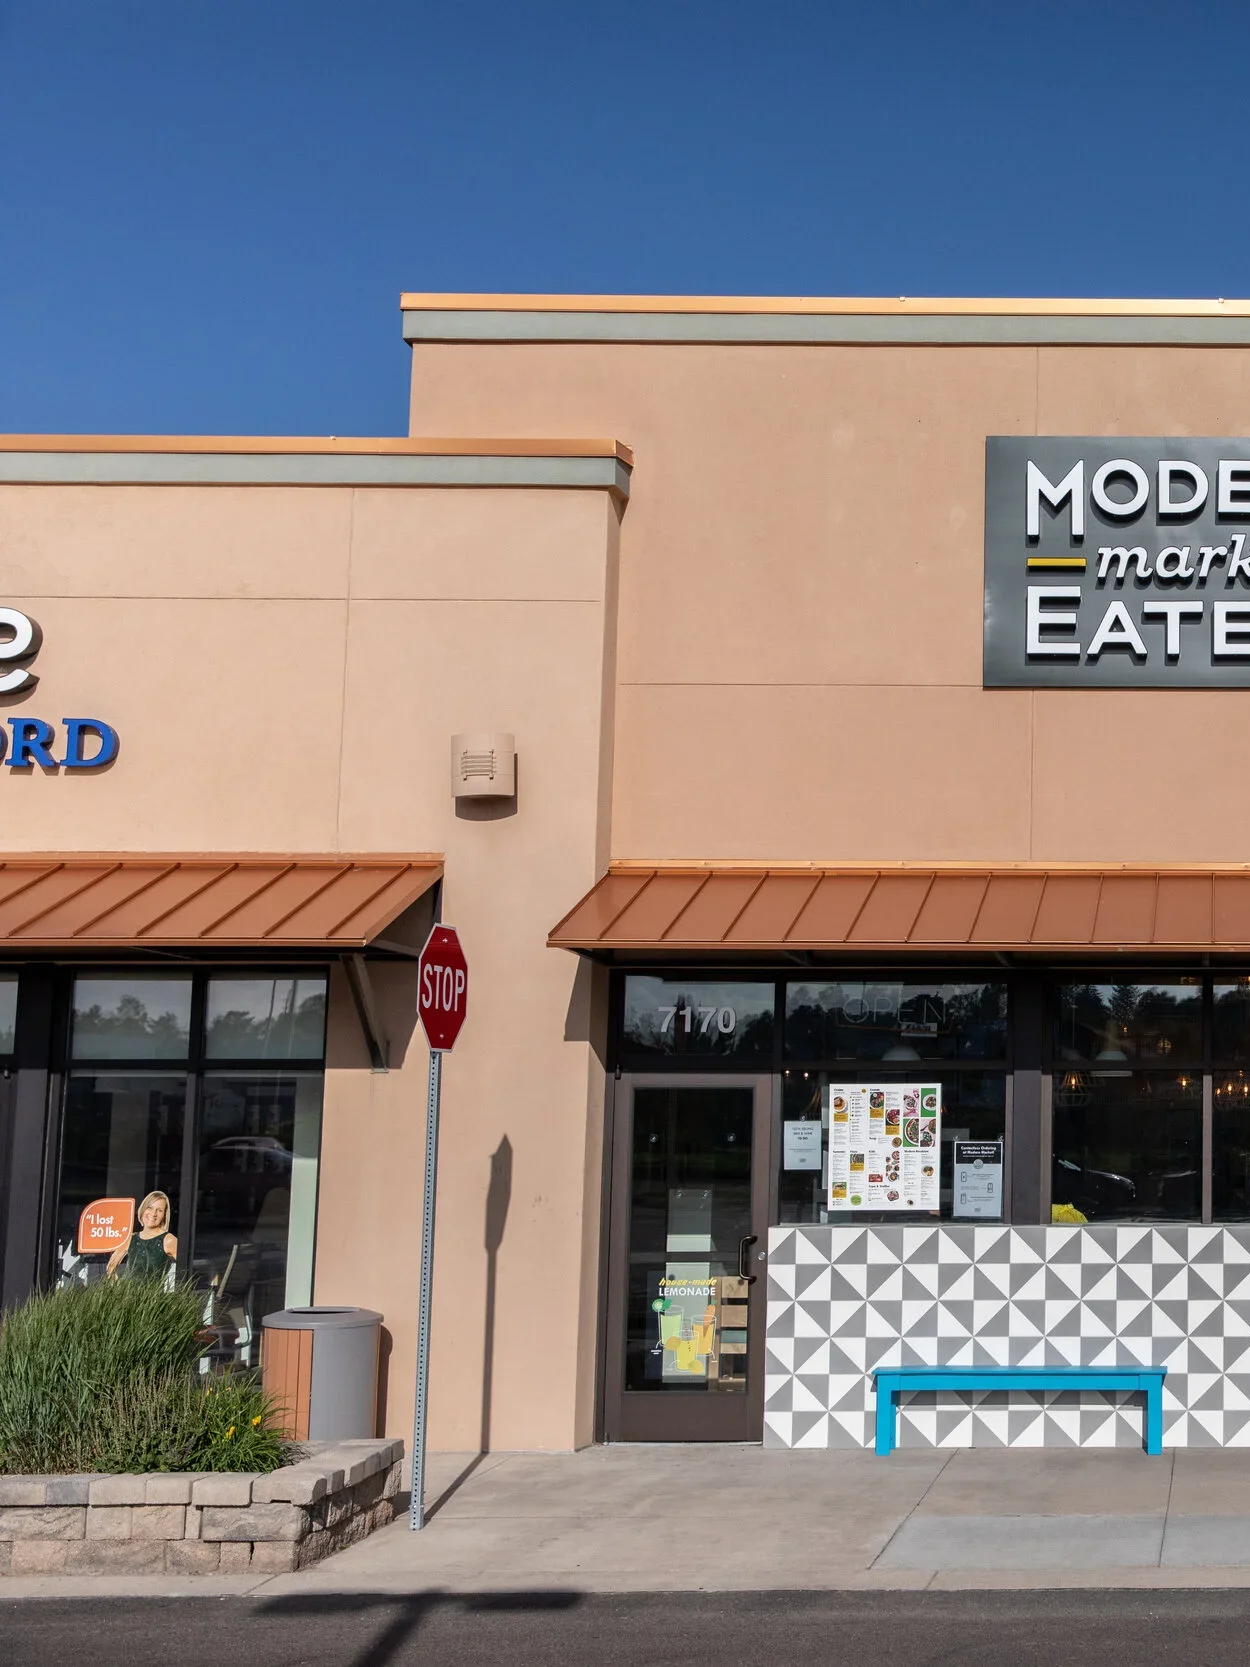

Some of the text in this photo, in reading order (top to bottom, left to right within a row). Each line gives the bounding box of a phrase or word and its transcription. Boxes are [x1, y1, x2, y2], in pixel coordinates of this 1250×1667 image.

[0, 717, 116, 768] RD
[422, 963, 465, 1012] STOP
[658, 1006, 738, 1033] 7170
[843, 997, 946, 1024] OPEN
[97, 1213, 114, 1224] lost
[91, 1226, 104, 1237] 50
[658, 1278, 717, 1286] house-made
[659, 1287, 716, 1296] LEMONADE
